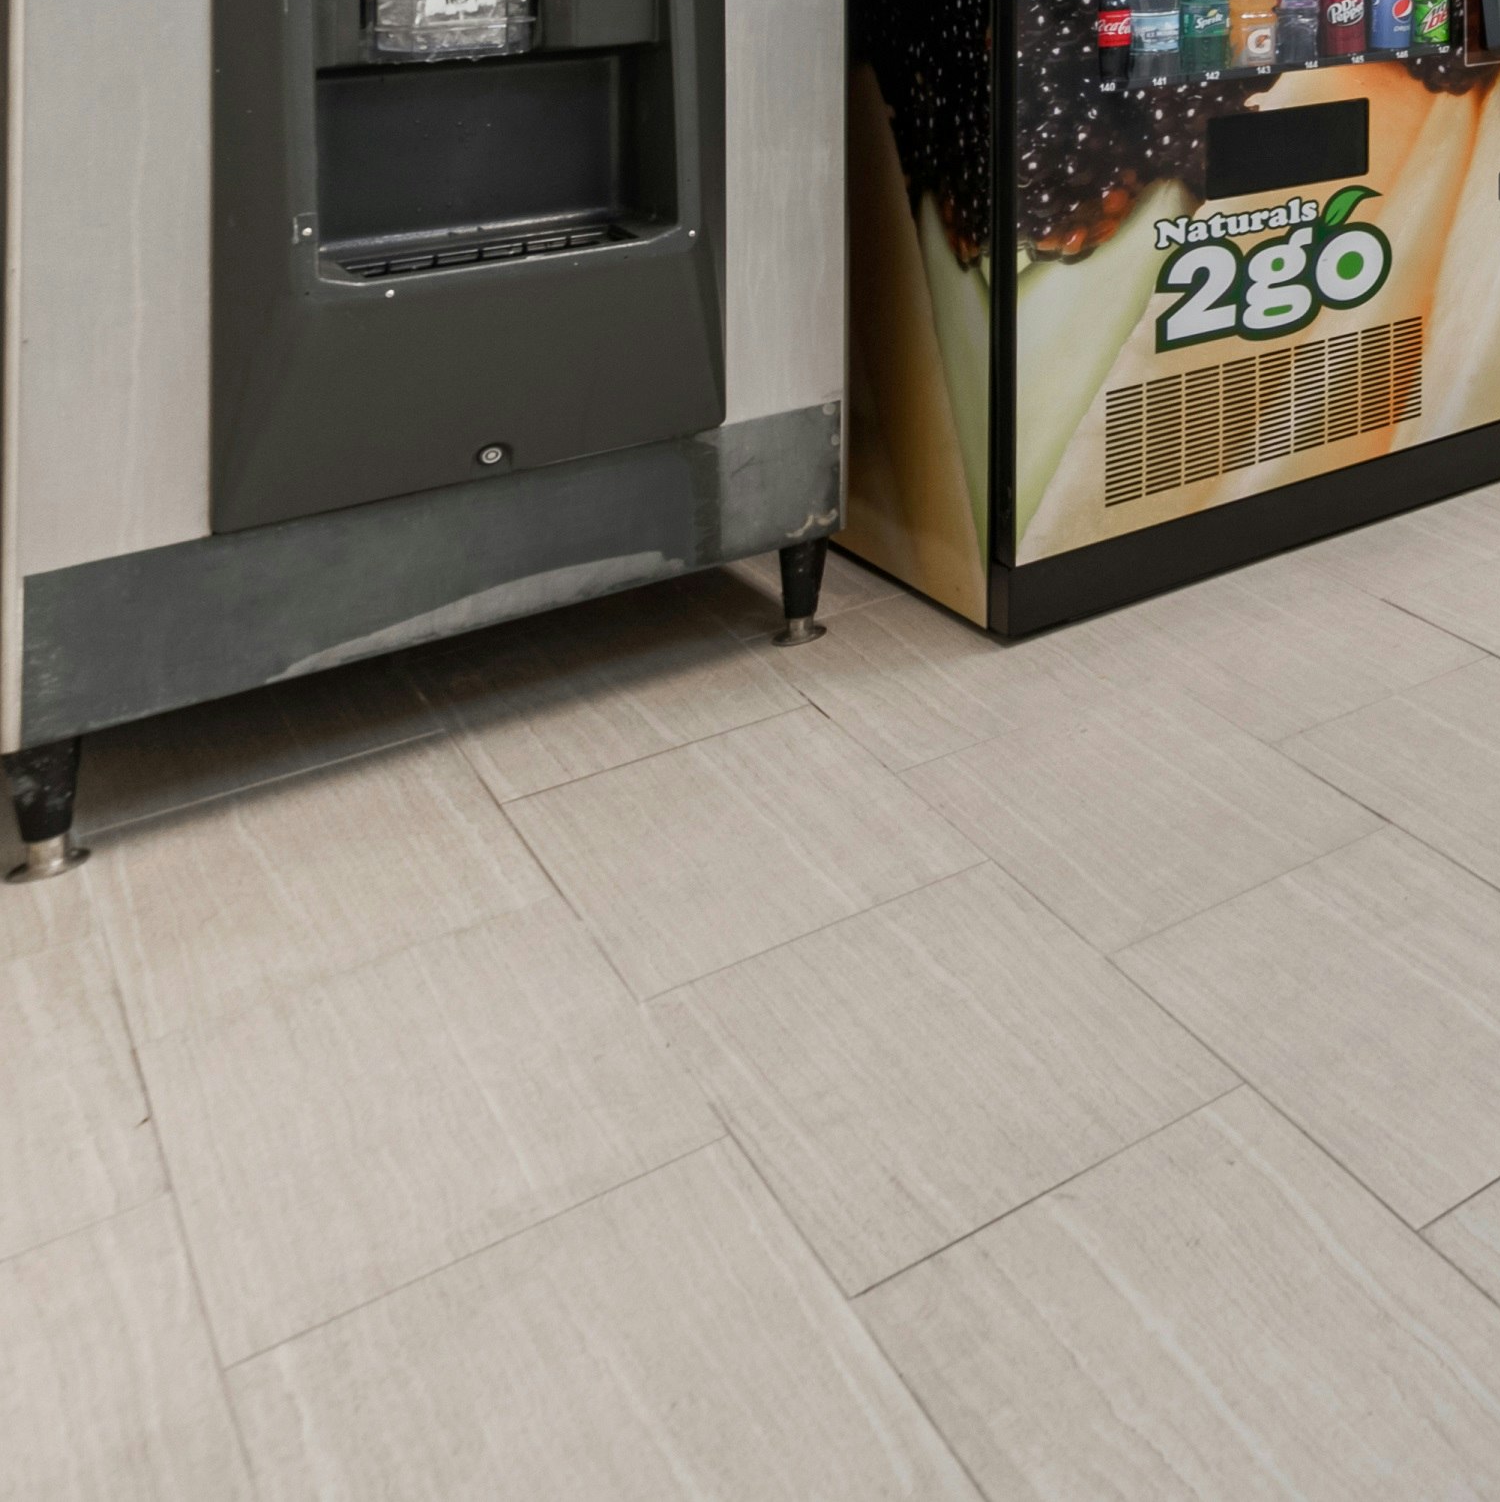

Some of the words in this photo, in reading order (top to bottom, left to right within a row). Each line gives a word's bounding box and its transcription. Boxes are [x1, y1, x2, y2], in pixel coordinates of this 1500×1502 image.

[1256, 66, 1271, 75] 143
[1205, 71, 1220, 81] 142
[1152, 77, 1167, 86] 141
[1100, 82, 1115, 92] 140
[1156, 196, 1319, 249] Naturals
[1163, 225, 1386, 343] 2go
